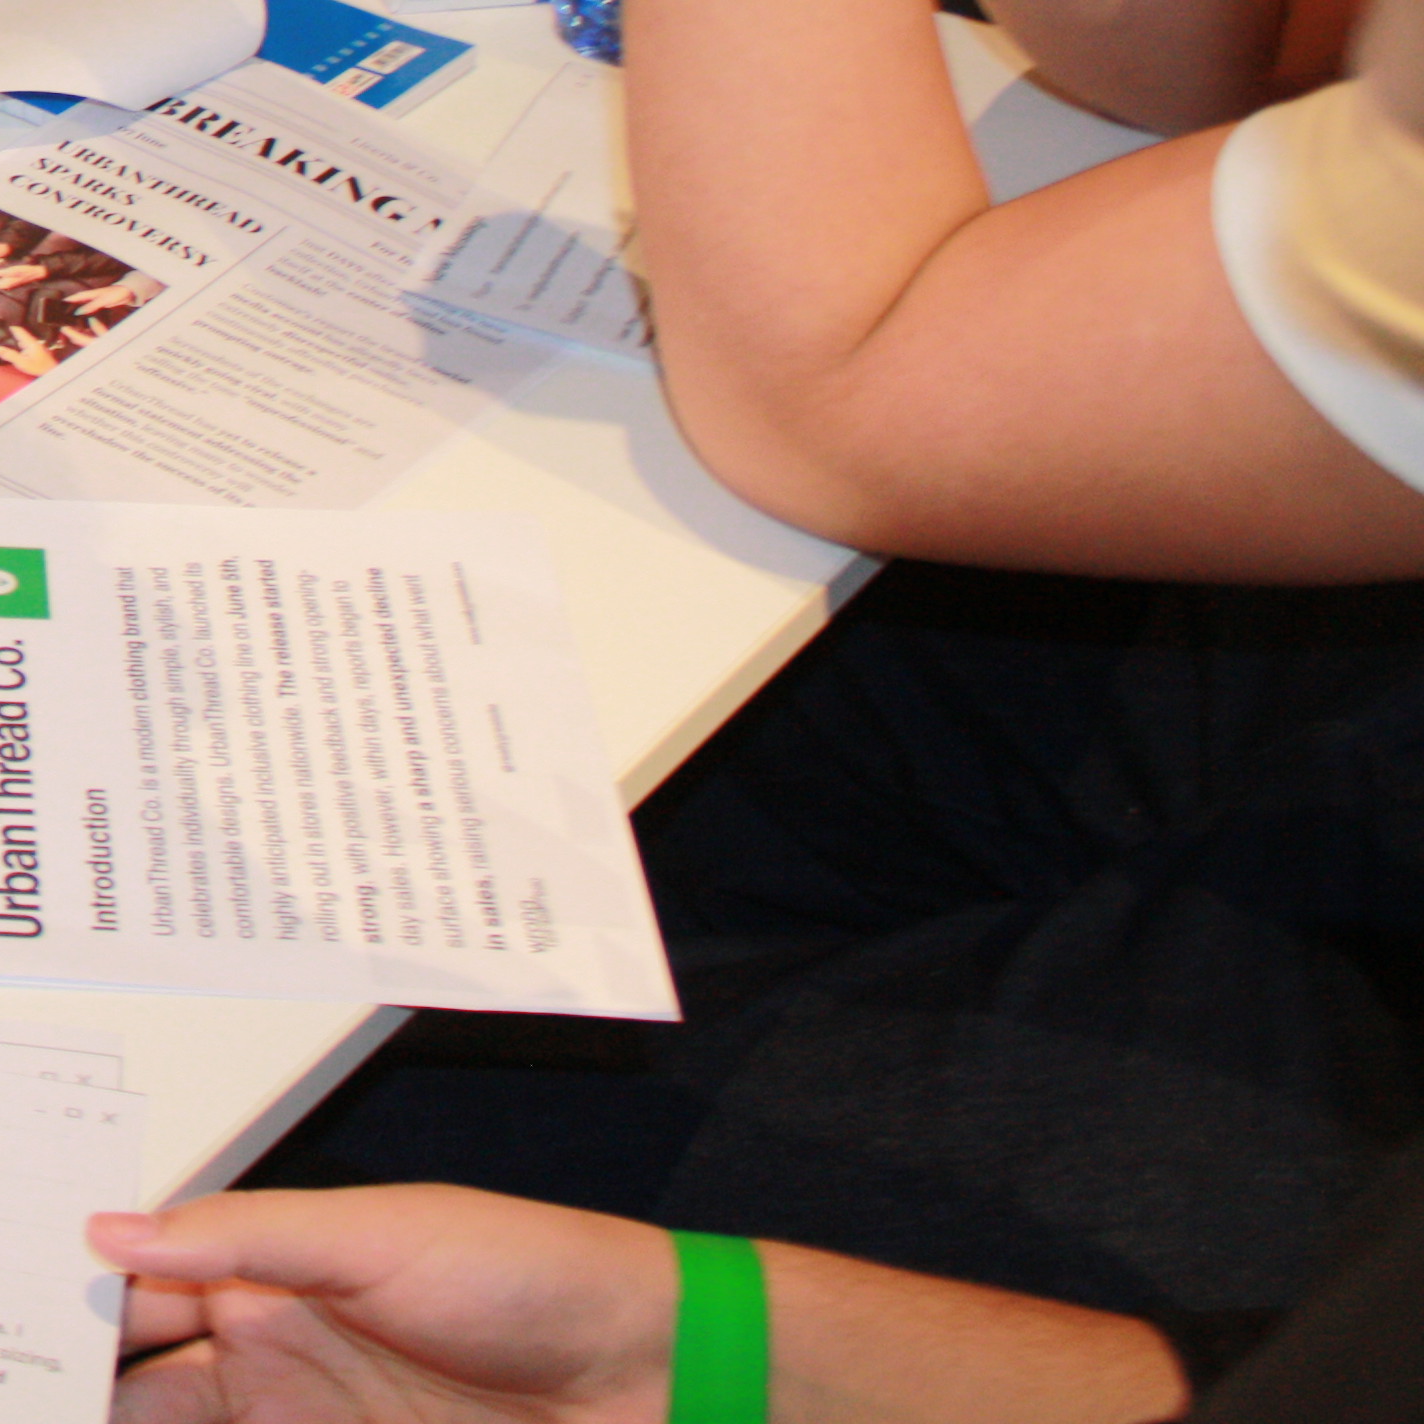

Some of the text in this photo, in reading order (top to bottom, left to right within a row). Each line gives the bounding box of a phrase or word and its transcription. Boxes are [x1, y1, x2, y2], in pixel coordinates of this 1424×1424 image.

[28, 155, 142, 208] SPARKS
[143, 89, 422, 224] BREAKING
[51, 138, 271, 236] URBANTHREAD
[1, 171, 221, 269] CONTROVERSY
[150, 567, 172, 591] and
[184, 562, 204, 576] its
[333, 580, 354, 592] to
[186, 580, 213, 639] launched
[223, 585, 248, 618] June
[336, 596, 364, 636] began
[195, 644, 217, 667] Co.
[232, 643, 255, 667] line
[233, 623, 251, 639] on
[307, 630, 336, 672] strong
[315, 677, 340, 703] and
[344, 640, 374, 689] reports
[166, 697, 196, 752] through
[199, 671, 231, 766] UrbanThread
[236, 671, 269, 726] clothing
[115, 567, 176, 936] UrbanThread Co. is a modern clothing brand that
[244, 731, 275, 795] inclusive
[257, 559, 347, 943] rolling out in stores nationwide. The release started
[320, 708, 353, 775] feedback
[362, 737, 391, 780] within
[366, 567, 466, 948] surface showing a sharp and unexpected decline
[173, 756, 208, 845] individuality
[333, 780, 368, 838] positive
[78, 787, 120, 932] Introduction
[254, 799, 294, 886] anticipated
[344, 842, 372, 875] with
[184, 849, 216, 938] celebrates
[221, 840, 255, 939] comfortable
[268, 891, 304, 940] highly
[396, 915, 428, 946] day
